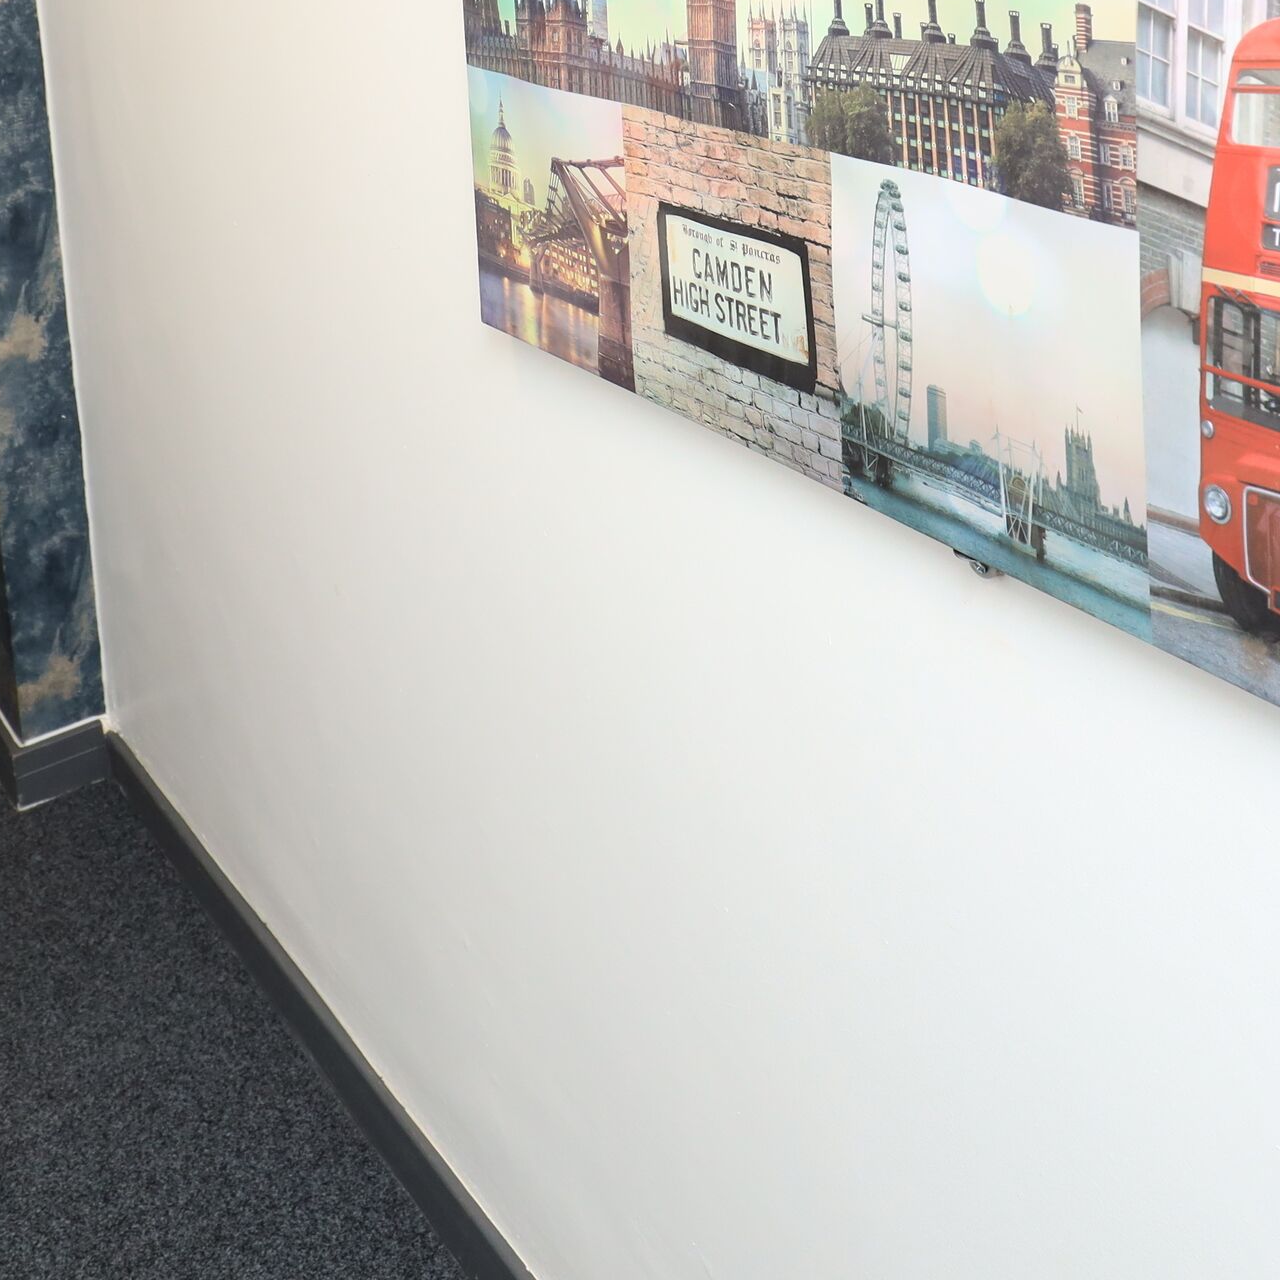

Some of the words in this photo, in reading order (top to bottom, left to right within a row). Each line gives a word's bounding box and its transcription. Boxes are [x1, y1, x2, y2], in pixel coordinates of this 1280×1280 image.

[692, 247, 773, 303] CAMDEN
[672, 275, 711, 318] HIGH
[714, 292, 782, 345] STREET
